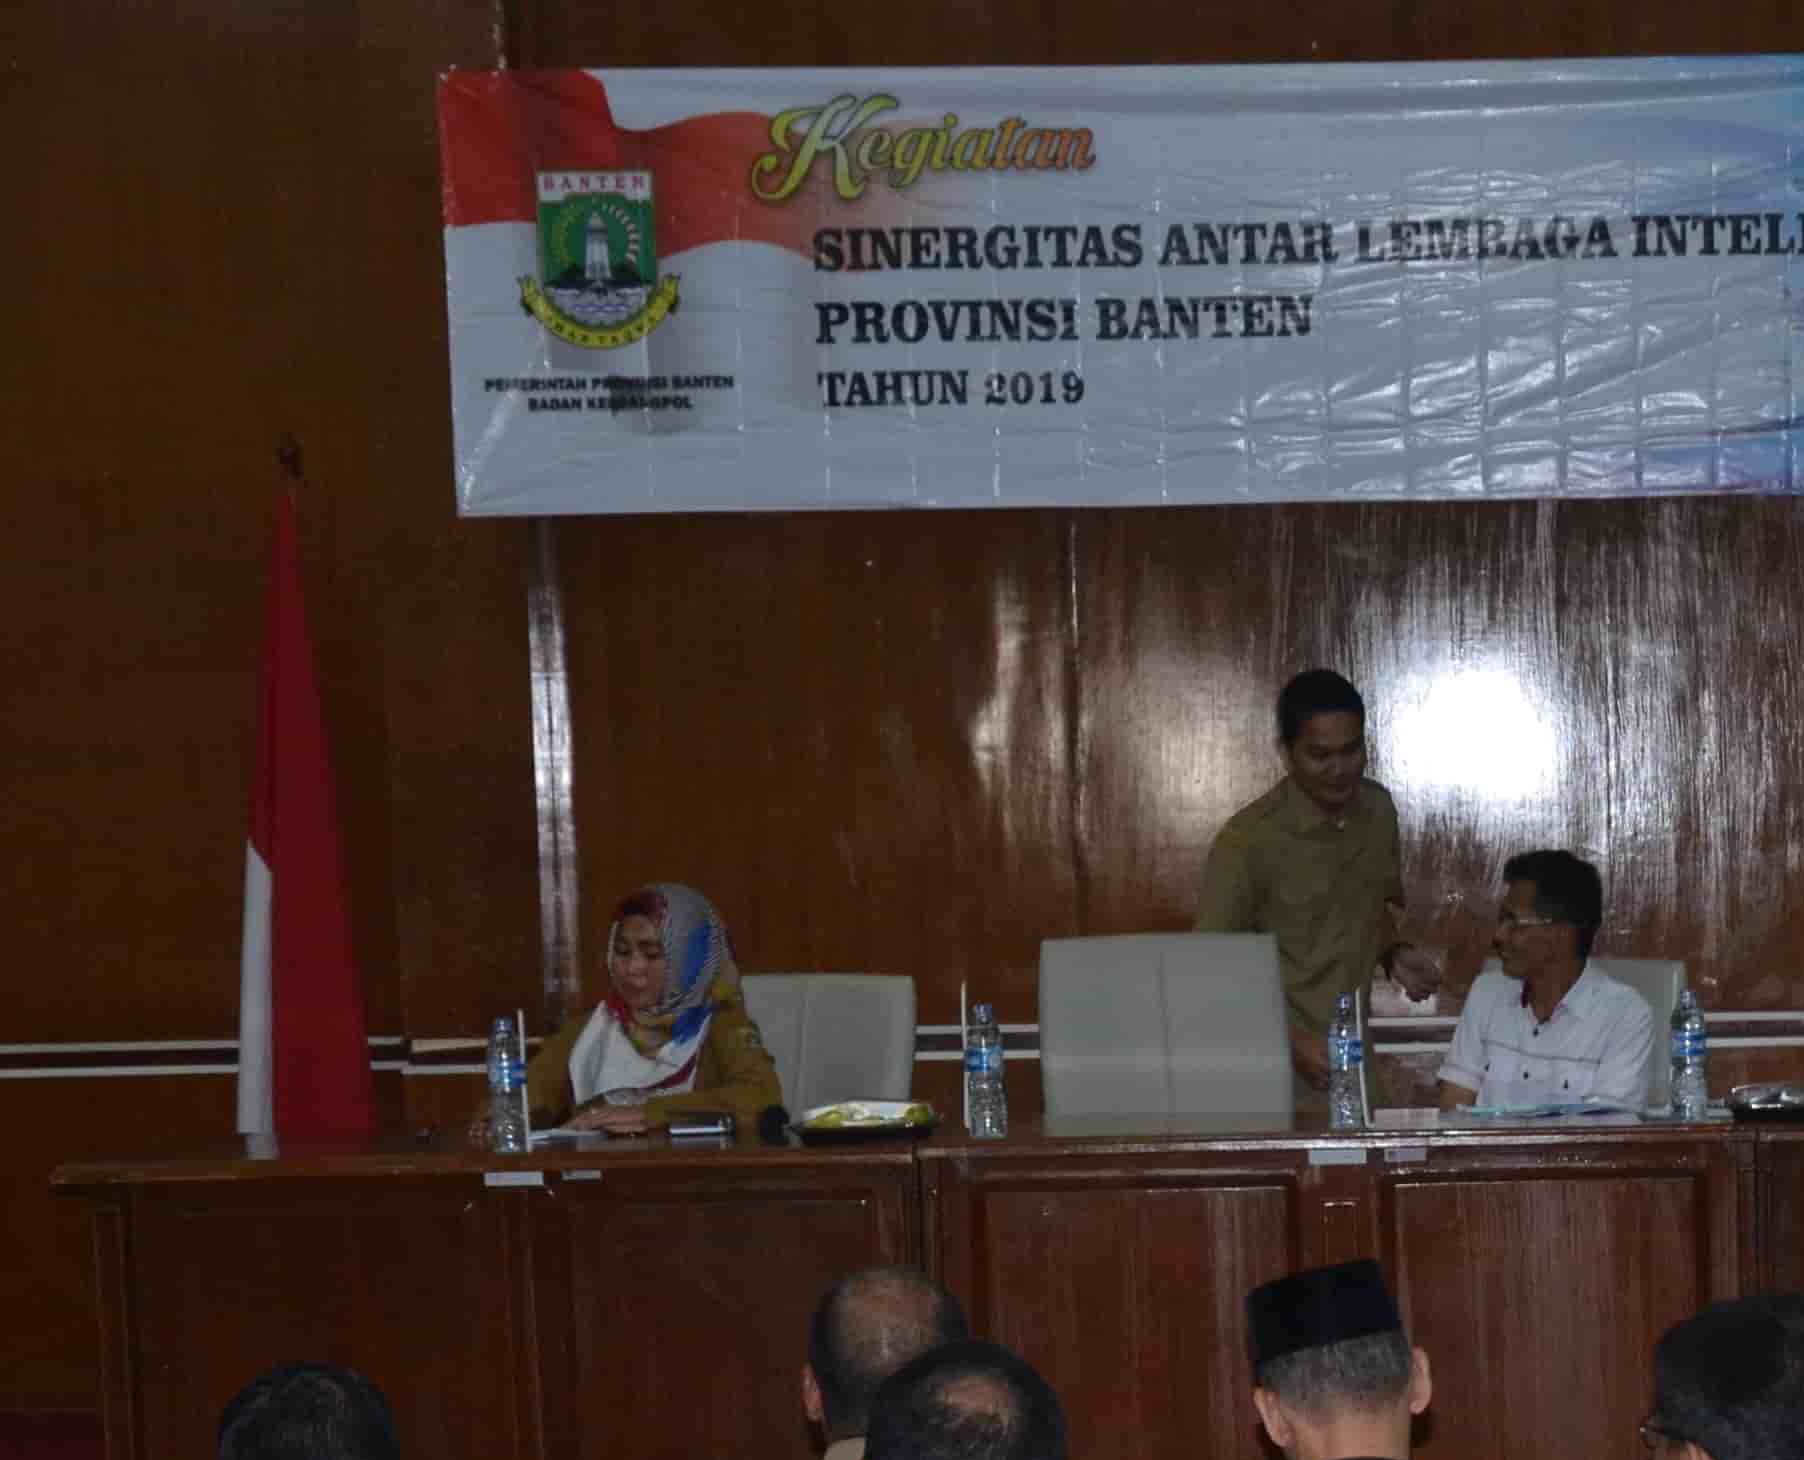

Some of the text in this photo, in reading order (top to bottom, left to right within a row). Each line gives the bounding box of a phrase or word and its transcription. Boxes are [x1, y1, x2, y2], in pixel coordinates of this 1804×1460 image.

[751, 93, 1096, 203] Kegiatan
[543, 176, 645, 191] BANTEN
[813, 224, 1143, 272] SINERGITAS
[1159, 221, 1339, 266] ANTAR
[1357, 216, 1619, 264] LEMBAGA
[813, 295, 1313, 345] PROVINSI BANTEN
[672, 375, 735, 390] BANTEN
[817, 369, 1086, 408] TAHUN 2019
[528, 397, 583, 412] BADAN
